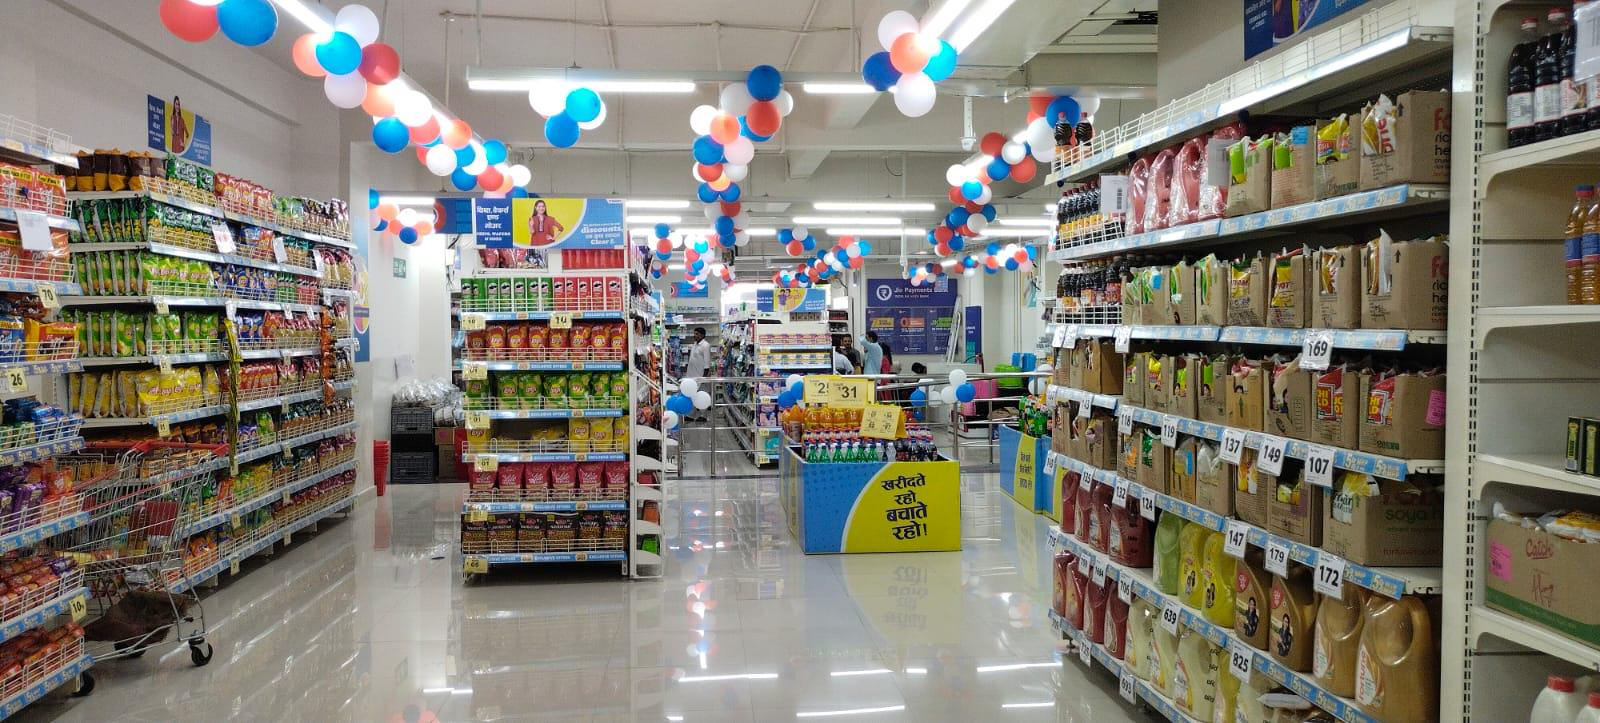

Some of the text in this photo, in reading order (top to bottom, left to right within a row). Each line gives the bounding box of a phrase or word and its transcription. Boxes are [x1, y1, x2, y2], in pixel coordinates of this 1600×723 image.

[42, 288, 54, 301] 70
[10, 373, 23, 386] 26
[817, 382, 829, 394] 2
[1163, 425, 1175, 438] 119
[1224, 438, 1241, 454] 137
[1263, 445, 1281, 463] 149
[1308, 456, 1330, 474] 107
[881, 473, 926, 491] खरीदते
[894, 490, 917, 505] रहो
[1116, 486, 1126, 499] 132
[886, 502, 928, 522] बचाते
[1142, 497, 1153, 512] 124
[892, 521, 928, 540] रहो!
[1228, 531, 1244, 547] 147
[1269, 547, 1285, 562] 179
[1318, 564, 1339, 587] 172
[1163, 608, 1177, 625] 639
[1232, 652, 1249, 673] 825
